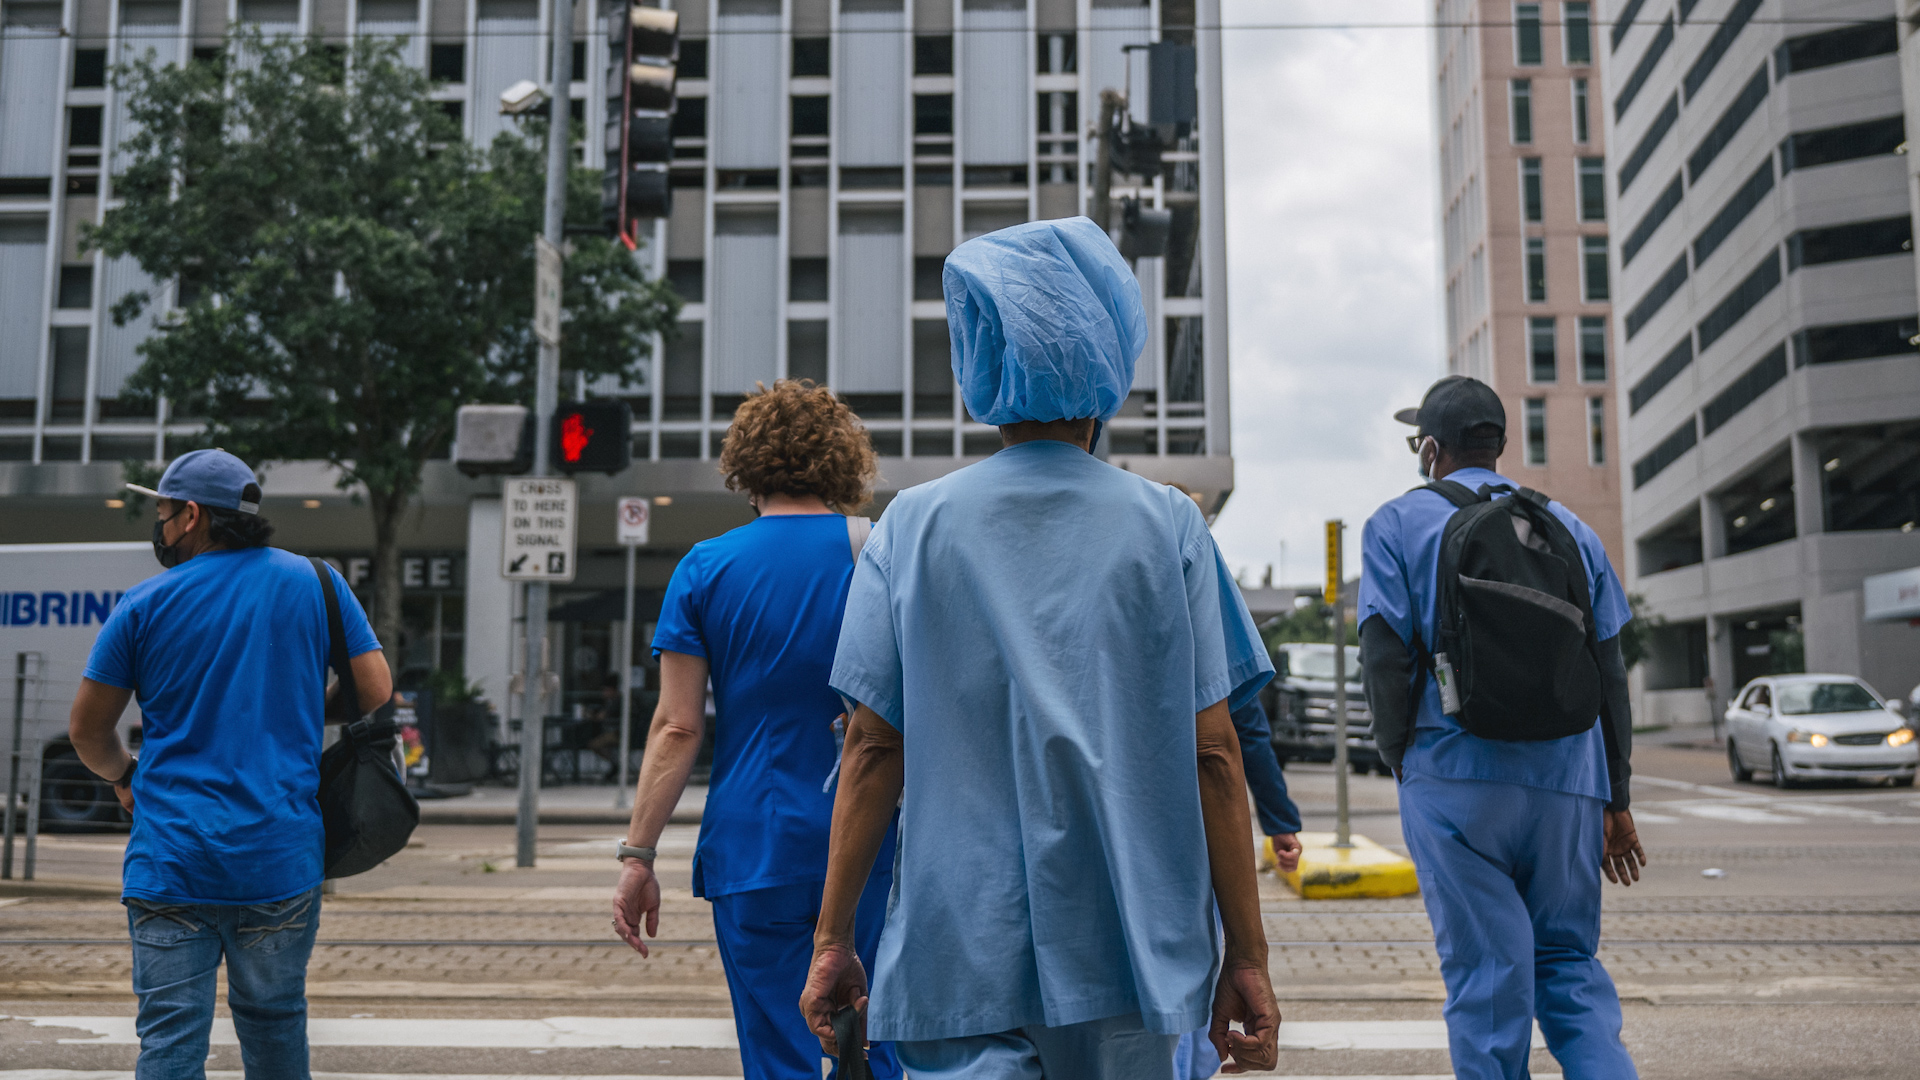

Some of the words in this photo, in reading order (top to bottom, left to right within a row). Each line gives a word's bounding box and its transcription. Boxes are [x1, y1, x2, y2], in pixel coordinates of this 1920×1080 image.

[520, 482, 561, 494] CROSS
[513, 500, 528, 511] TO
[535, 501, 566, 512] HERE
[514, 517, 530, 528] ON
[538, 516, 565, 529] THIS
[517, 534, 560, 546] SIGNAL
[11, 592, 125, 625] BRIN
